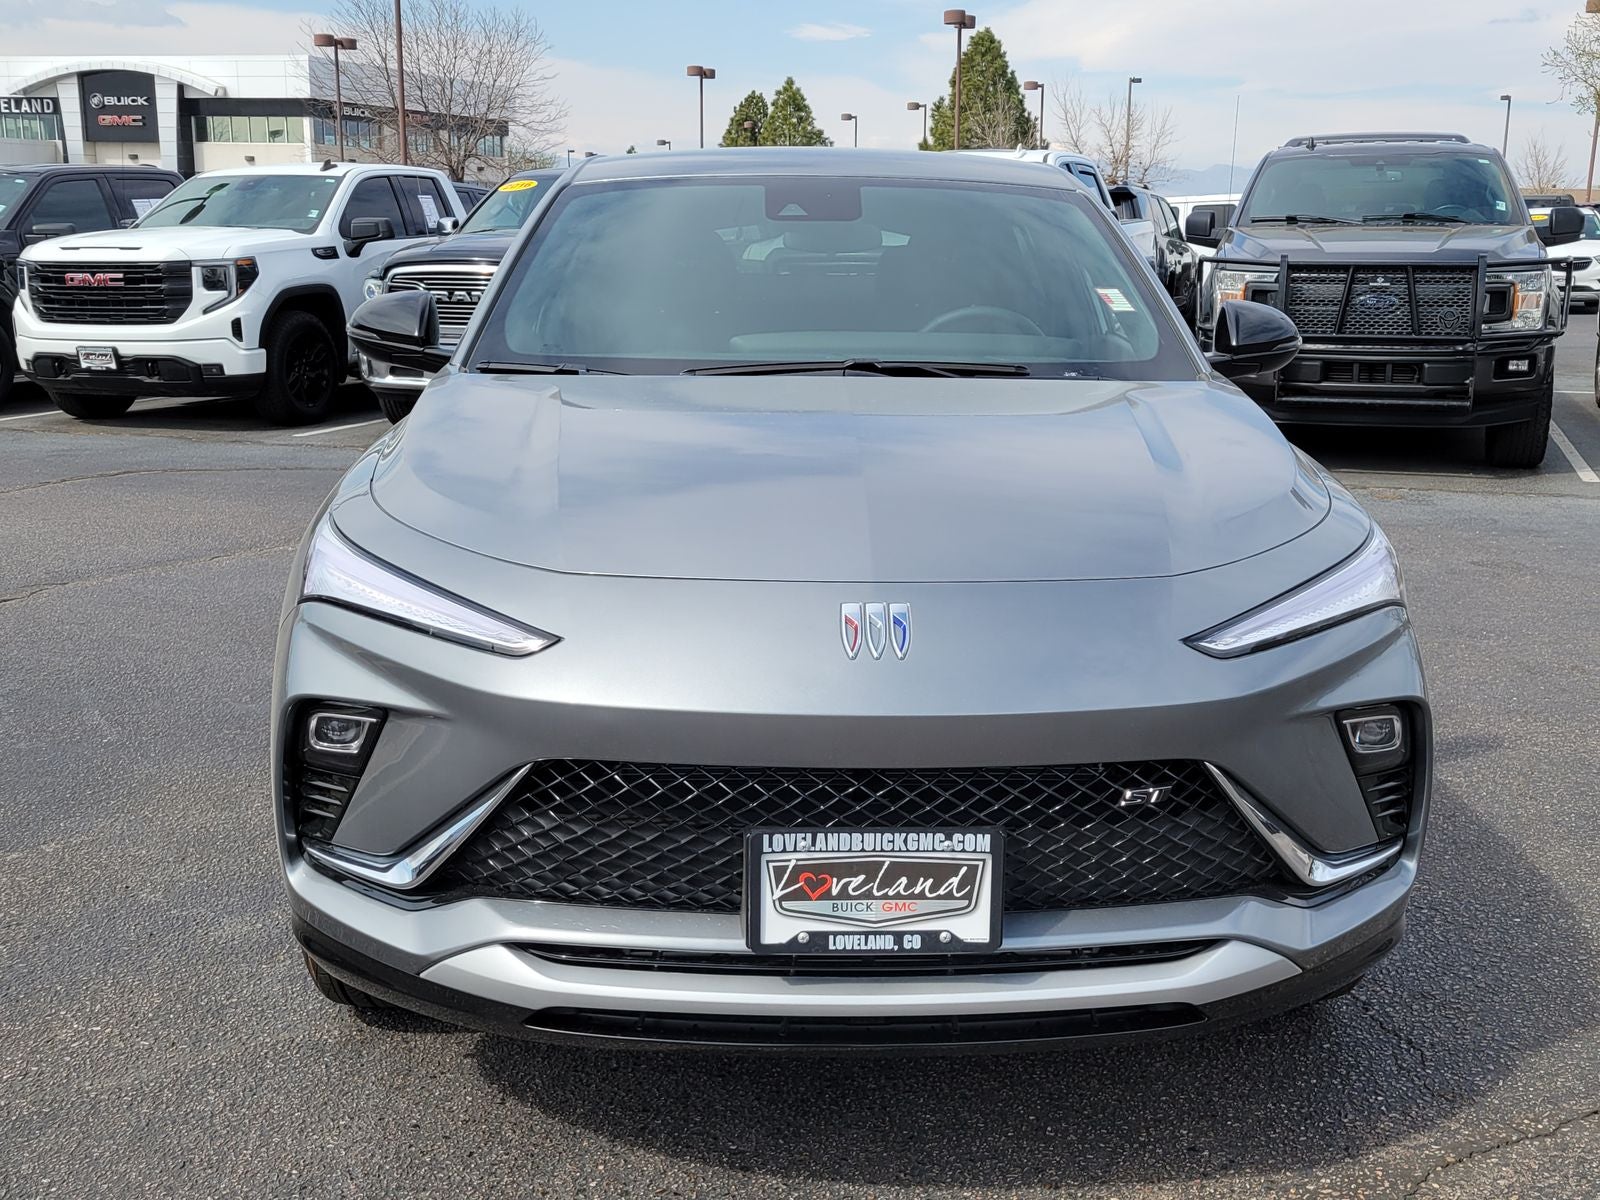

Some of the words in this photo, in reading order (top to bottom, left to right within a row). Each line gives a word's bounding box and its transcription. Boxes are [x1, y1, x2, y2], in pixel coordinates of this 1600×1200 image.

[103, 96, 149, 106] BUICK
[97, 115, 143, 126] GMC
[64, 272, 124, 287] GMC
[1120, 785, 1172, 806] ST
[763, 833, 990, 852] LOVELANDBUICKGMCCOM
[772, 859, 971, 901] Loveland
[832, 902, 874, 912] BUICK
[881, 902, 918, 912] GMC
[829, 935, 899, 951] LOVELAND,
[903, 934, 921, 949] CO
